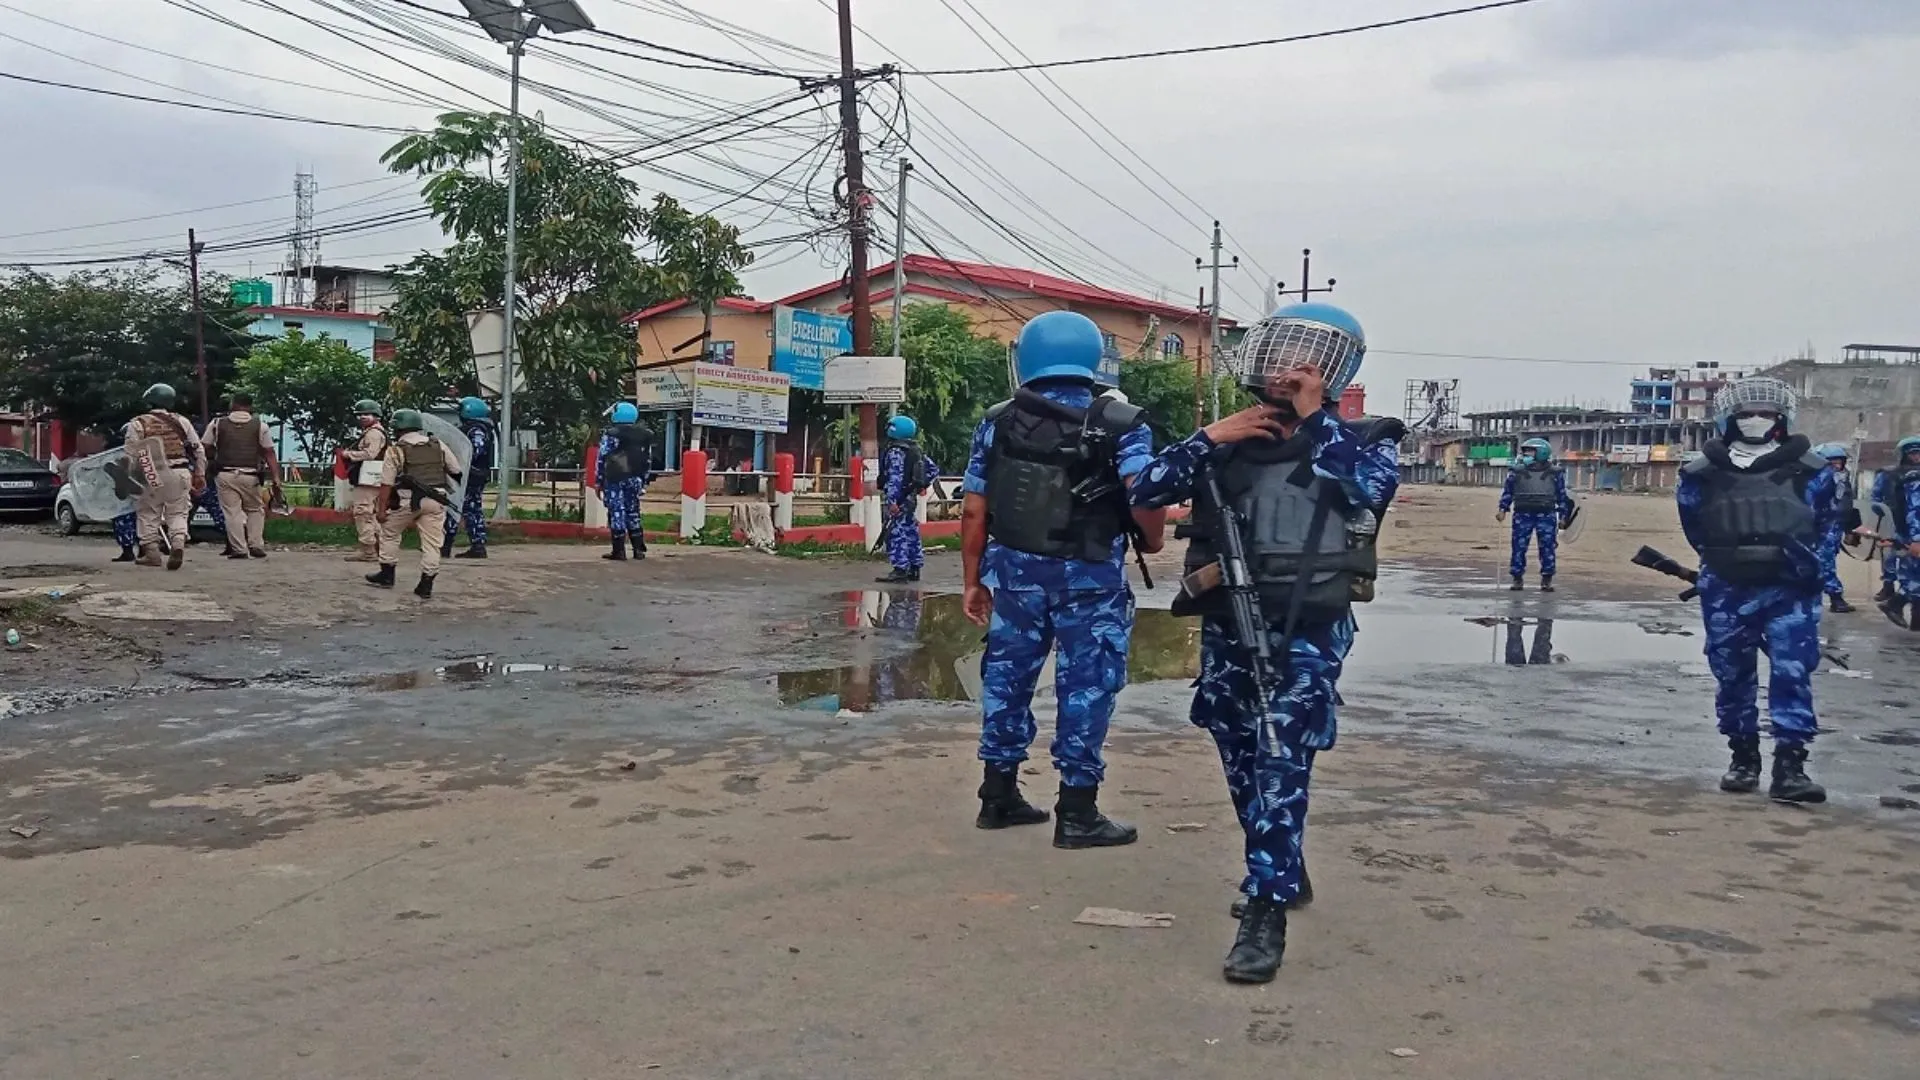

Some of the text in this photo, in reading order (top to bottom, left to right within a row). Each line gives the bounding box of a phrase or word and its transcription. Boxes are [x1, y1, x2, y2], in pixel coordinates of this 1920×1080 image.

[793, 321, 841, 345] EXCELLENCY
[792, 341, 818, 358] PHYSICS
[697, 367, 724, 377] DIRECT
[726, 372, 769, 383] ADMISSION
[770, 377, 789, 385] OPEN
[138, 448, 161, 489] POLICE
